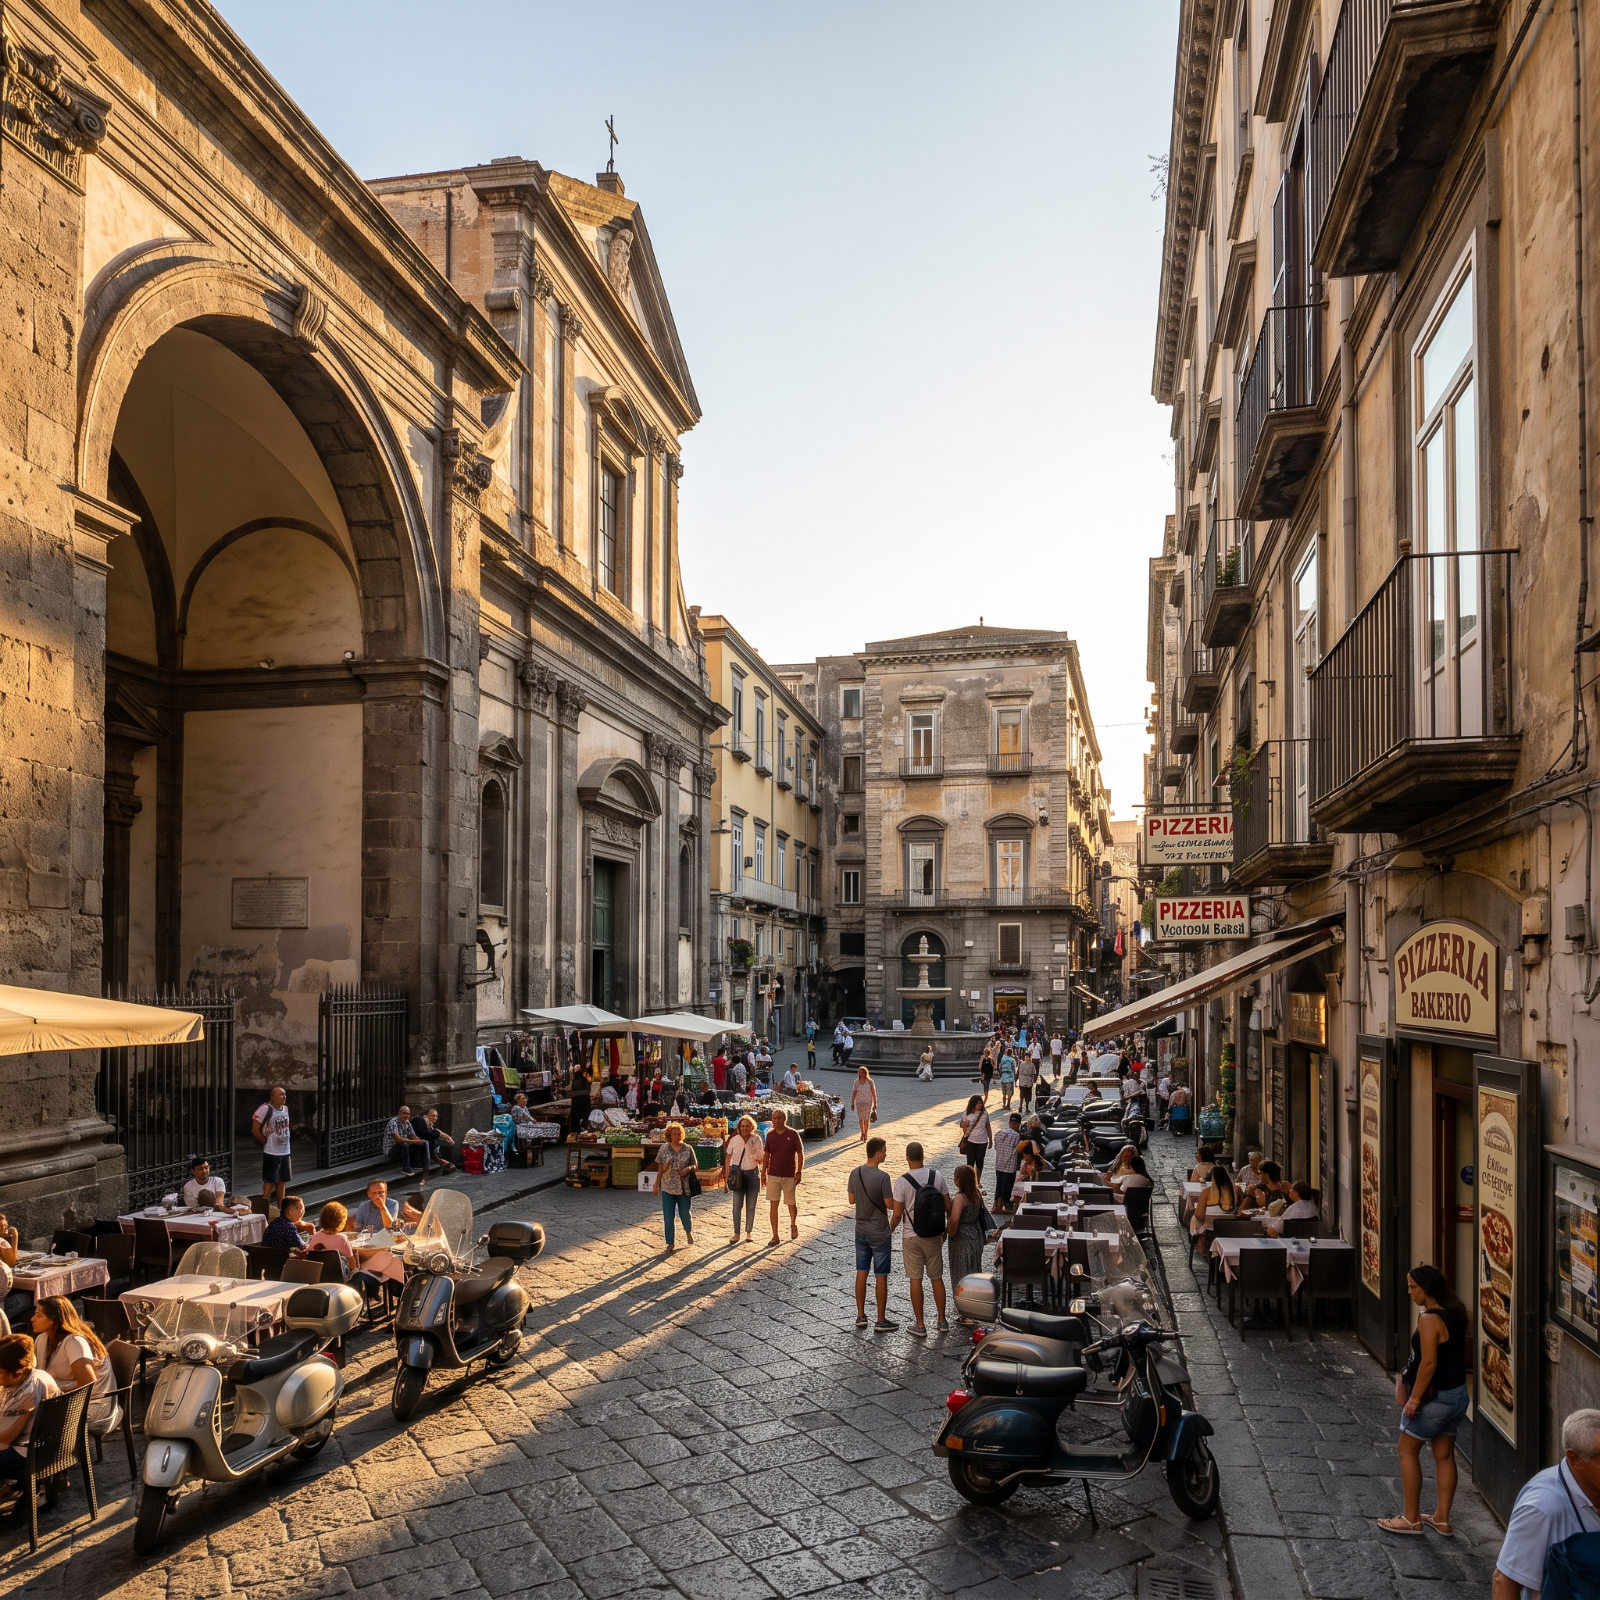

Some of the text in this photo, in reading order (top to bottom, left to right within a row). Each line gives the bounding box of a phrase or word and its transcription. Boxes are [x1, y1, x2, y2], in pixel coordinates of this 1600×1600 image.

[1160, 900, 1245, 920] PIZZERIA
[1397, 932, 1489, 1002] PIZZERIA
[1411, 992, 1471, 1023] BAKERIO
